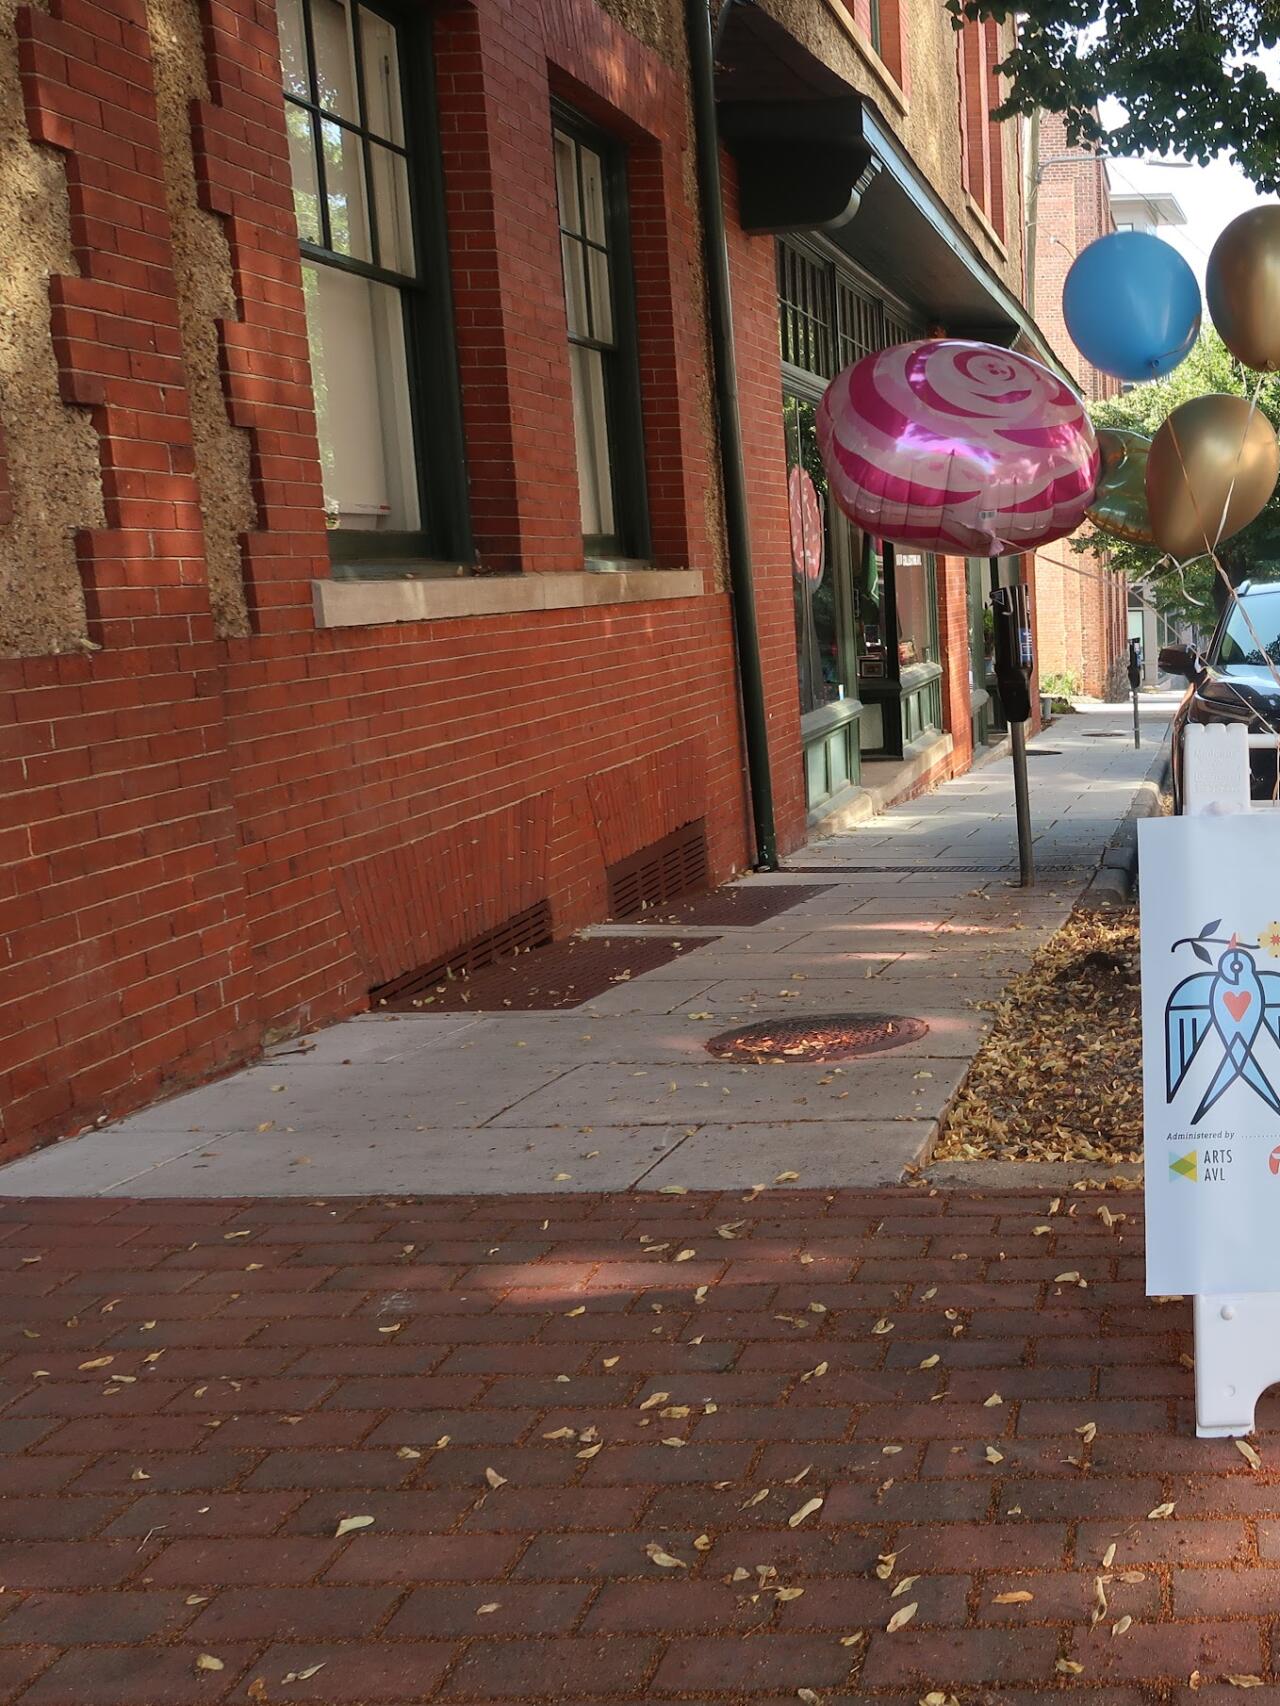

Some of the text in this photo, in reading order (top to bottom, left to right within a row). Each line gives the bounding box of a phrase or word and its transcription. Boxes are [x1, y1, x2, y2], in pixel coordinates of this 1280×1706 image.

[1166, 1131, 1235, 1140] Administered by
[1204, 1150, 1232, 1164] ARTS
[1204, 1168, 1225, 1182] AVL
